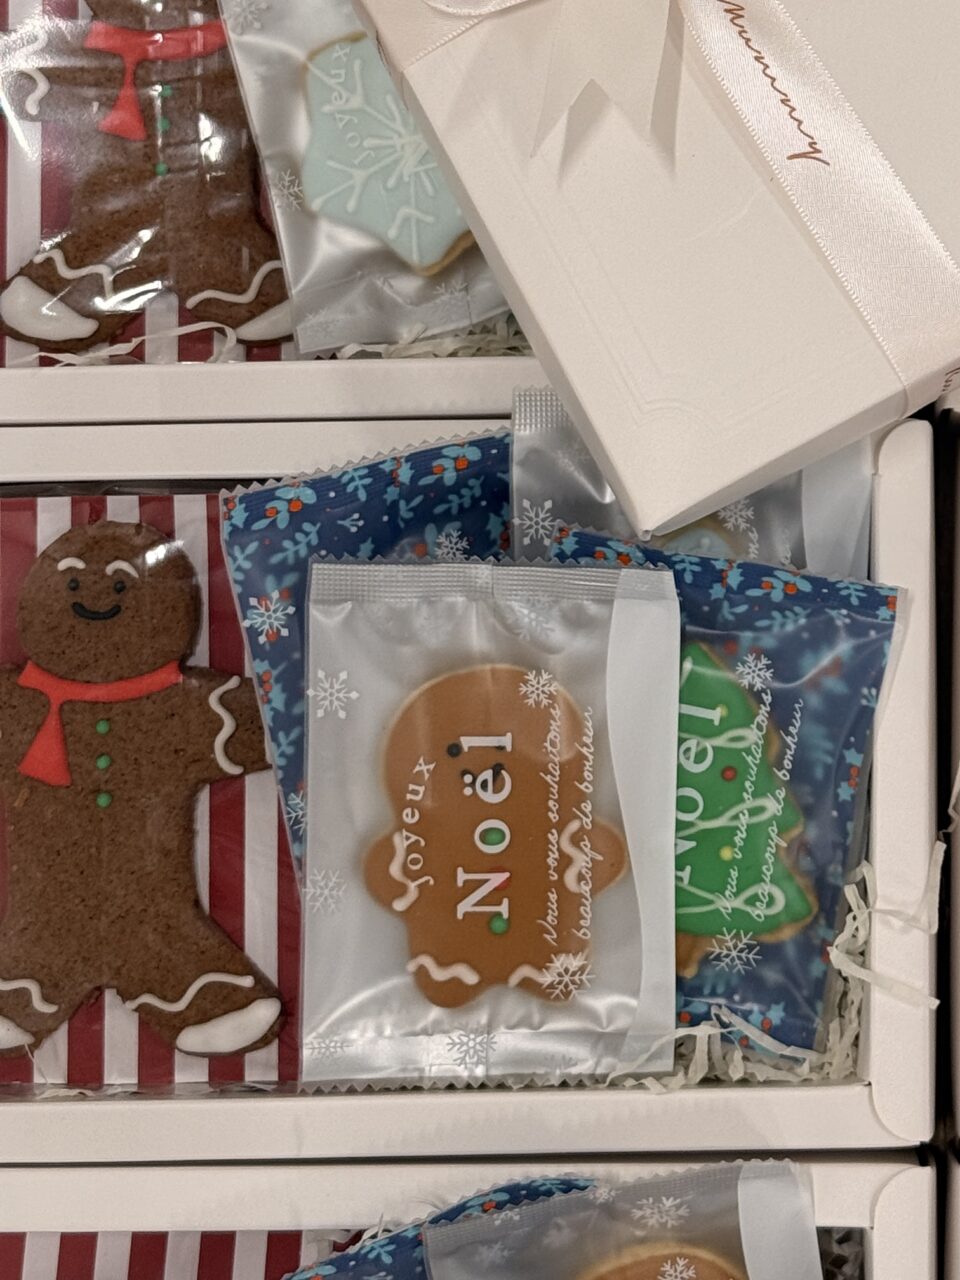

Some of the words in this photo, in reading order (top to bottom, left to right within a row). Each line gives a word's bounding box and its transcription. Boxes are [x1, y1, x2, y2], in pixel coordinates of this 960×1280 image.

[540, 703, 561, 823] souhaitons
[574, 706, 594, 794] bonheur
[772, 698, 804, 782] bonheur
[402, 756, 436, 888] Joyeux
[456, 732, 512, 919] Noël
[545, 827, 560, 881] vous
[572, 799, 593, 830] de
[536, 887, 558, 946] Nous
[571, 835, 604, 940] beaucoup
